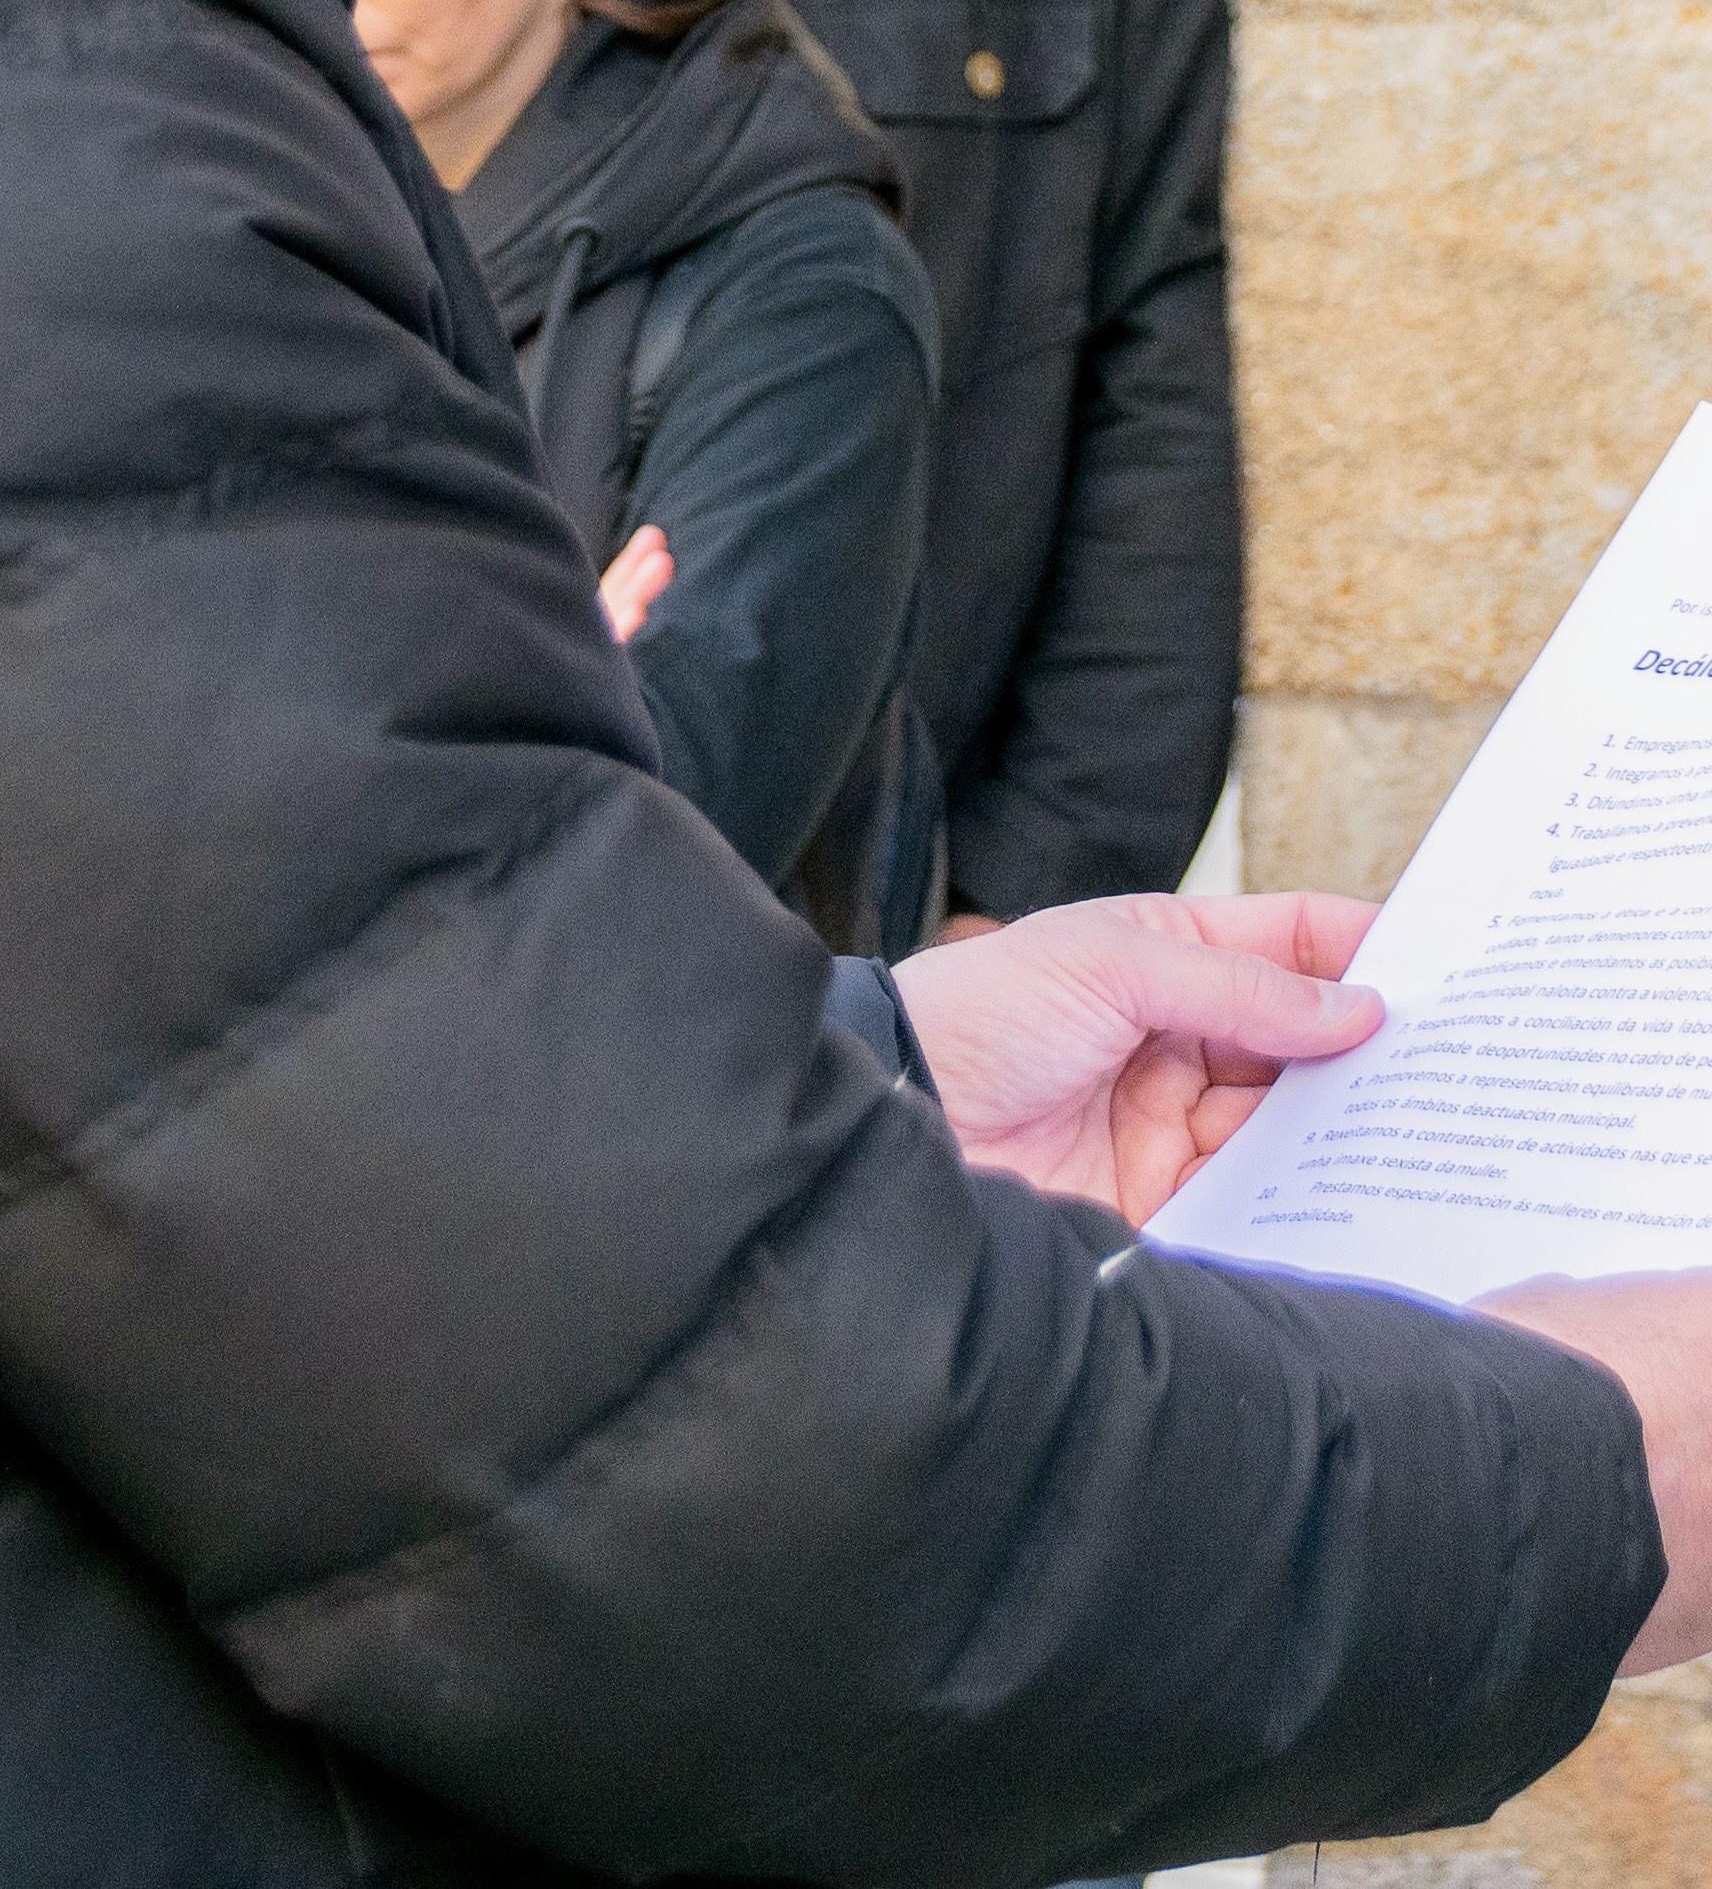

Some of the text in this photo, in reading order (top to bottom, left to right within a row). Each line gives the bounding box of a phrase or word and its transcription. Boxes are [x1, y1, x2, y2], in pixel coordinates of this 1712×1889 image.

[1670, 598, 1699, 614] Por
[1602, 733, 1616, 748] 1.
[1624, 735, 1712, 755] Empregamos
[1583, 762, 1598, 778] 2.
[1605, 766, 1683, 784] Integramos
[1565, 792, 1579, 807] 3.
[1587, 796, 1664, 811] Difundimos
[1546, 822, 1561, 838] 4.
[1570, 824, 1651, 841] Traballamos
[1588, 986, 1639, 1001] contra
[1638, 988, 1650, 1000] a
[1413, 1012, 1504, 1032] Respectamos
[1507, 1014, 1521, 1027] a
[1523, 1013, 1613, 1032] conciliación
[1616, 1016, 1637, 1032] da
[1642, 1017, 1674, 1034] vida
[1606, 1051, 1630, 1065] no
[1629, 1049, 1674, 1067] cadro
[1674, 1052, 1697, 1068] de
[1455, 1073, 1469, 1085] a
[1468, 1071, 1581, 1095] representación
[1580, 1077, 1665, 1100] equilibrada
[1665, 1082, 1688, 1100] de
[1380, 1095, 1400, 1110] os
[1399, 1094, 1460, 1115] ámbitos
[1556, 1109, 1636, 1132] municipal.
[1401, 1128, 1416, 1141] a
[1415, 1127, 1519, 1153] contratación
[1516, 1138, 1539, 1153] de
[1538, 1140, 1627, 1162] actividades
[1629, 1149, 1658, 1165] nas
[1659, 1150, 1691, 1170] que
[1331, 1151, 1379, 1168] imaxe
[1378, 1154, 1433, 1173] sexista
[1309, 1180, 1382, 1199] Prestamos
[1383, 1185, 1445, 1205] especial
[1444, 1191, 1513, 1212] atención
[1531, 1200, 1602, 1221] mulleres
[1601, 1208, 1625, 1224] en
[1623, 1208, 1695, 1230] situación
